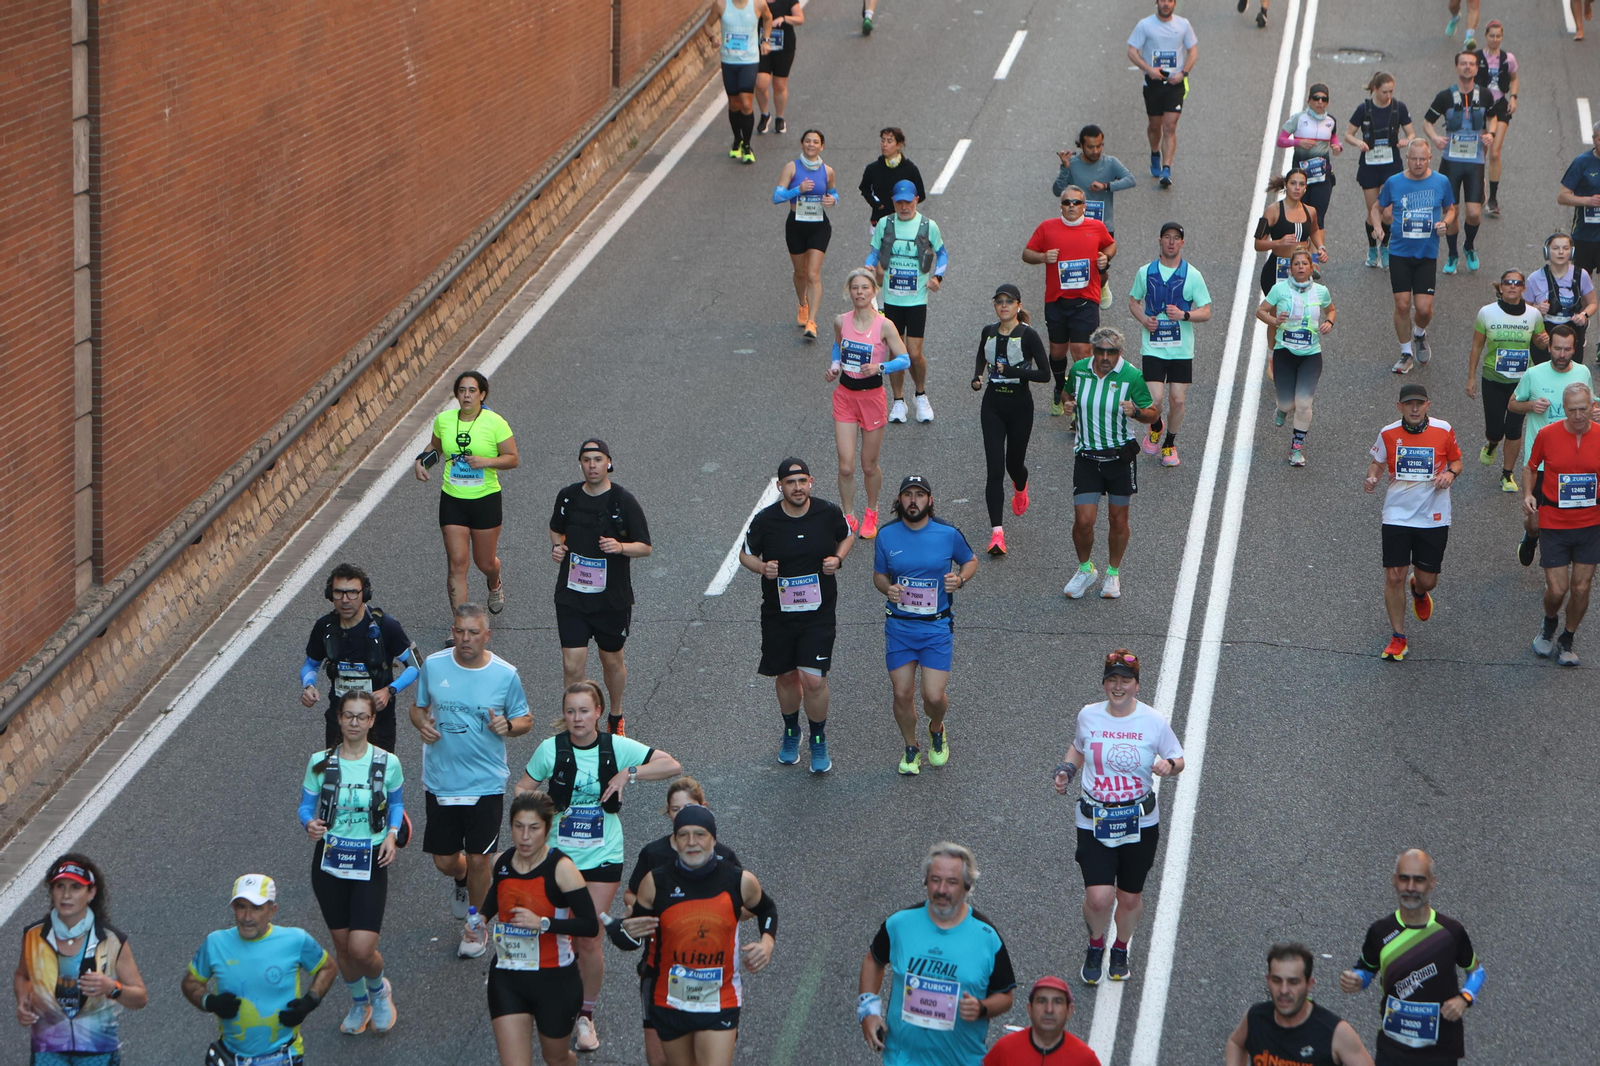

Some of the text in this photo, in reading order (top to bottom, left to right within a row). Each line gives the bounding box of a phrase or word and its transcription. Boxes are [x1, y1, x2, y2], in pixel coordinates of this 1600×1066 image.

[1093, 776, 1143, 791] MILE
[1110, 809, 1134, 817] ZURICH
[573, 822, 591, 830] 12729
[506, 927, 532, 935] ZURICH
[907, 957, 928, 976] VI
[927, 960, 958, 979] TRAIL
[688, 970, 716, 979] ZURICH
[922, 981, 952, 992] ZURICH
[920, 997, 937, 1007] 6820
[910, 1006, 946, 1019] IGNACIO SVQ
[1403, 1005, 1432, 1014] ZURICH
[1400, 1019, 1421, 1028] 13020
